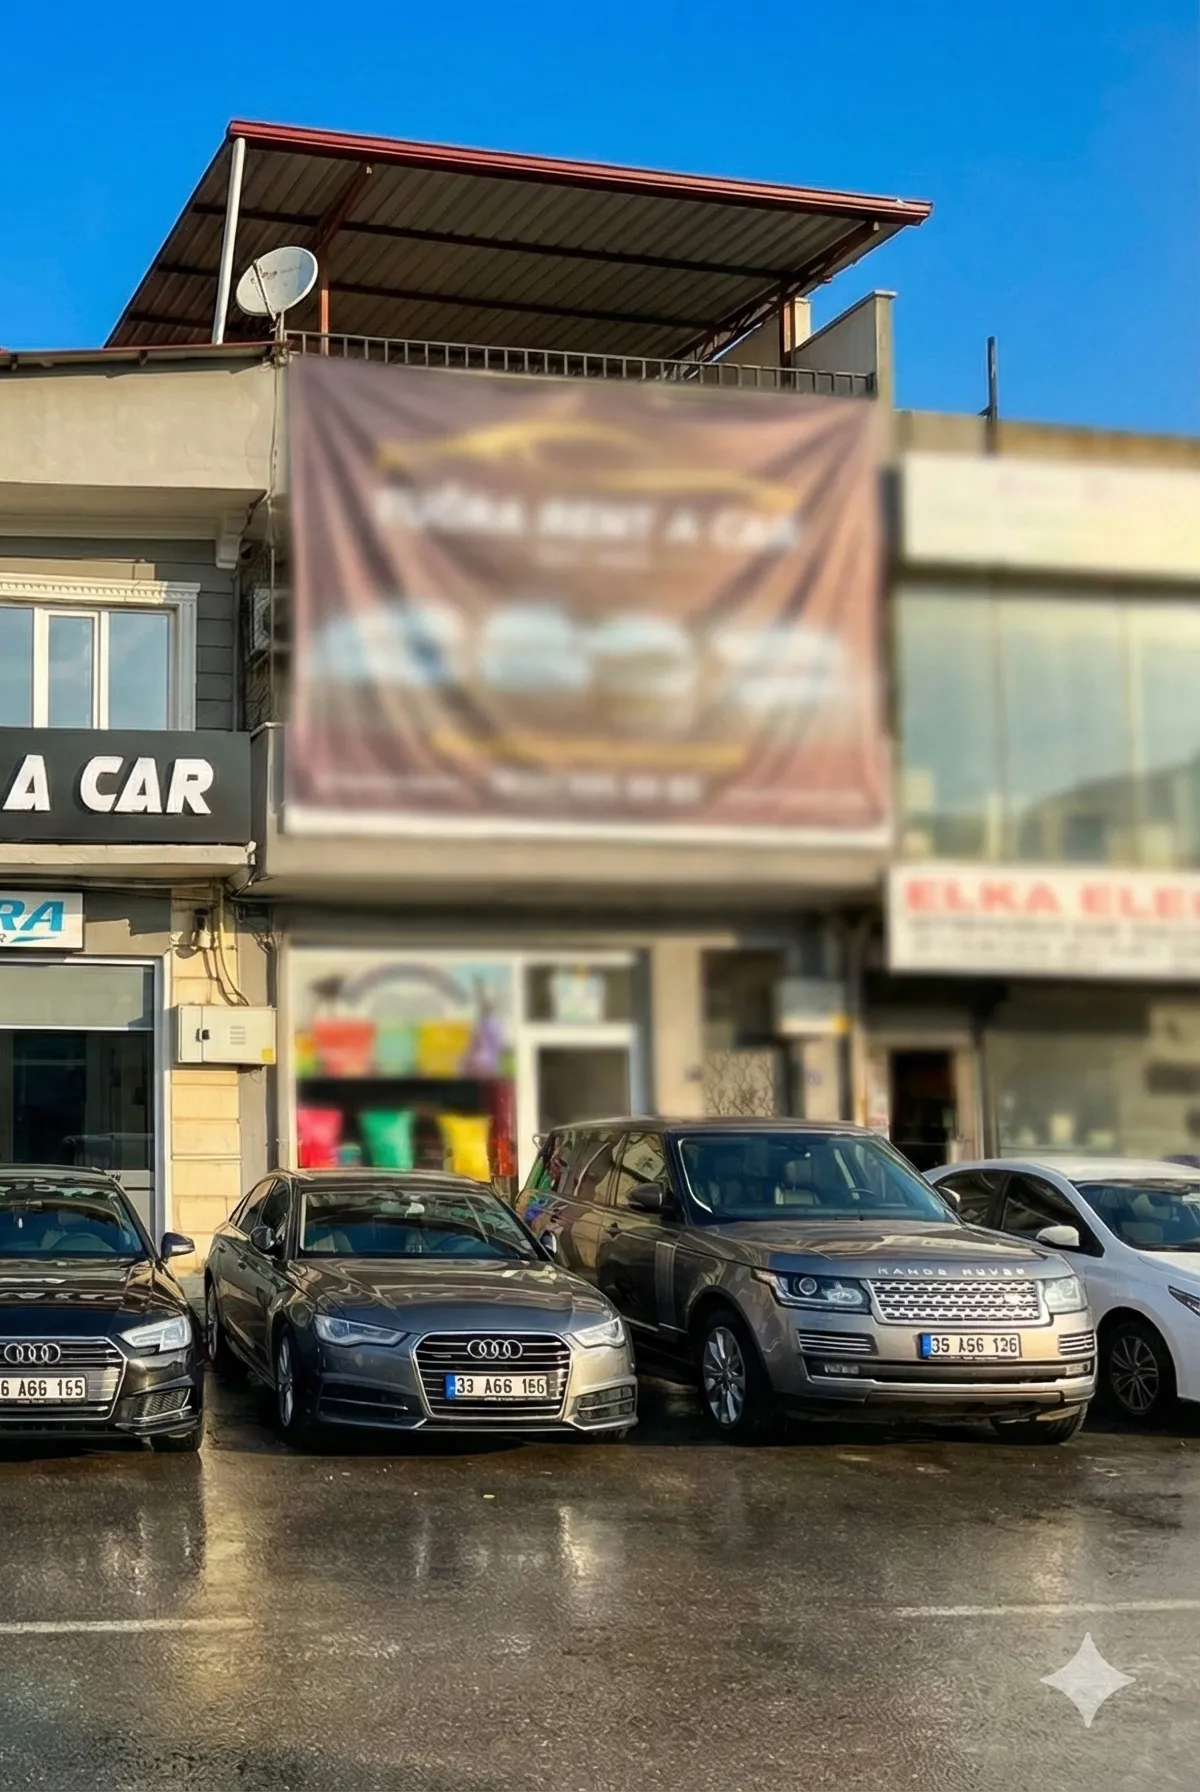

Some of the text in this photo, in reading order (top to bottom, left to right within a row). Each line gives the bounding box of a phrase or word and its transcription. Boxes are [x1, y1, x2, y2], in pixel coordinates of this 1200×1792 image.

[2, 754, 50, 812] A
[80, 756, 214, 814] CAR
[905, 877, 1200, 920] ELKA ELE
[931, 1337, 950, 1354] 35
[456, 1377, 474, 1394] 33
